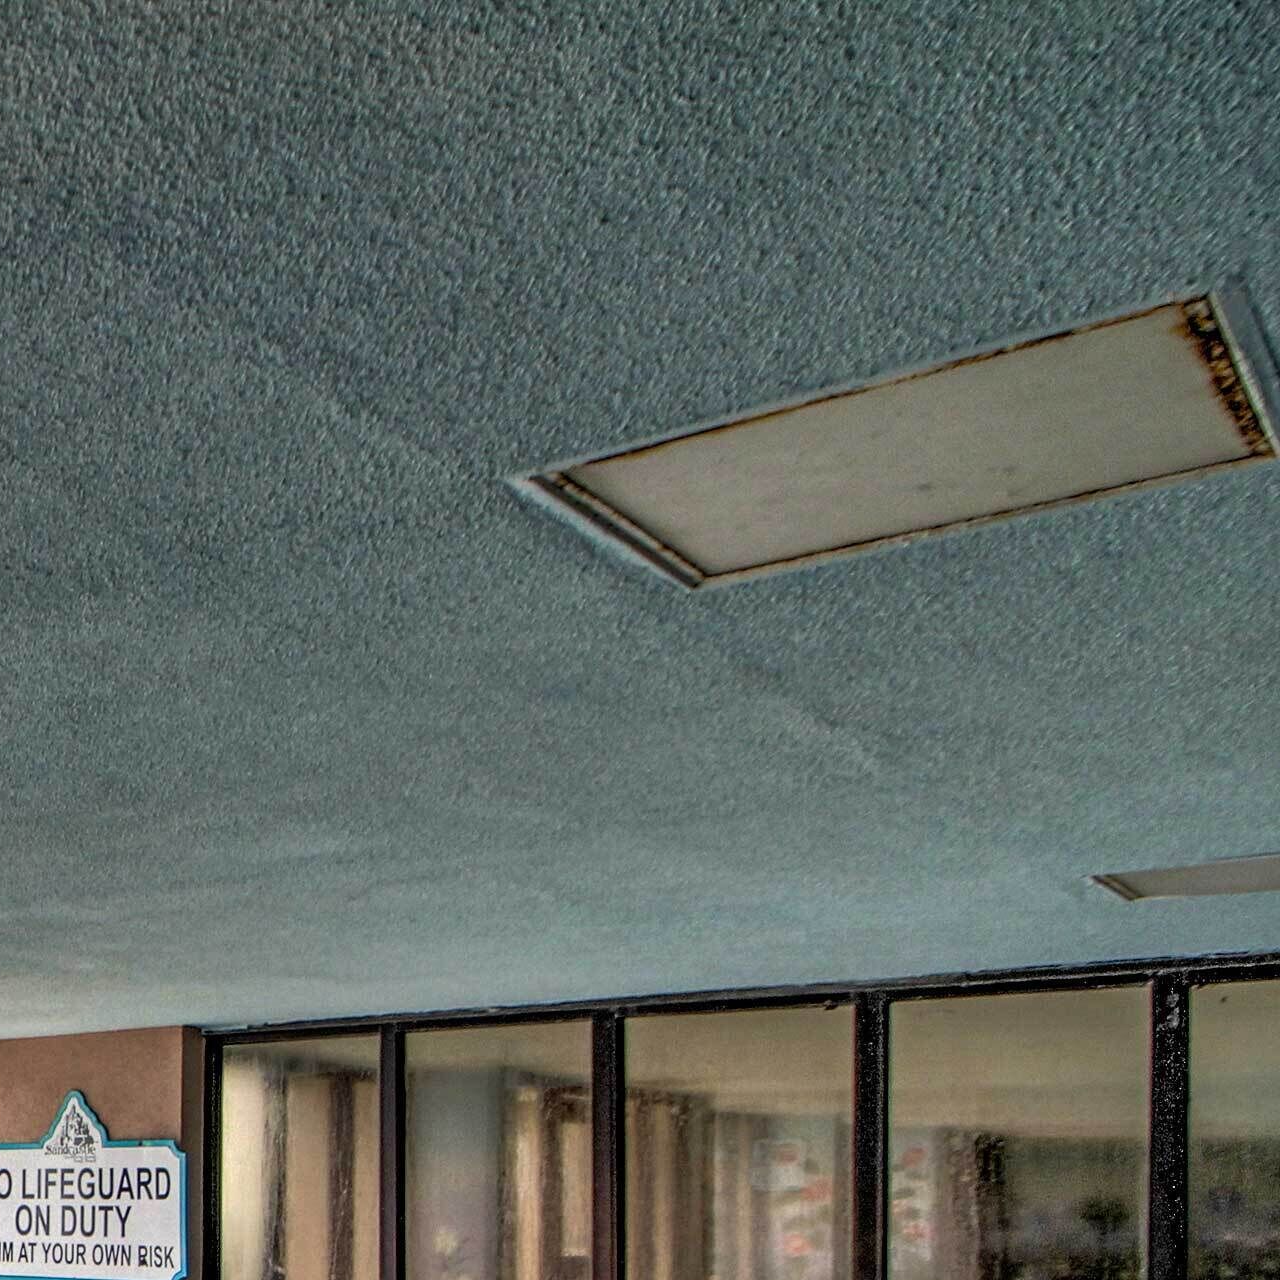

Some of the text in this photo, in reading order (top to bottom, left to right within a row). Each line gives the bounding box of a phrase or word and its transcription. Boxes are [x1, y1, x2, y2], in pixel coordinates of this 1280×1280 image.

[22, 1167, 172, 1200] LIFEGUARD
[15, 1204, 132, 1237] ON DUTY
[18, 1242, 37, 1263] AT
[42, 1242, 87, 1265] YOUR
[92, 1243, 132, 1267] OWN
[138, 1244, 175, 1269] RISK
